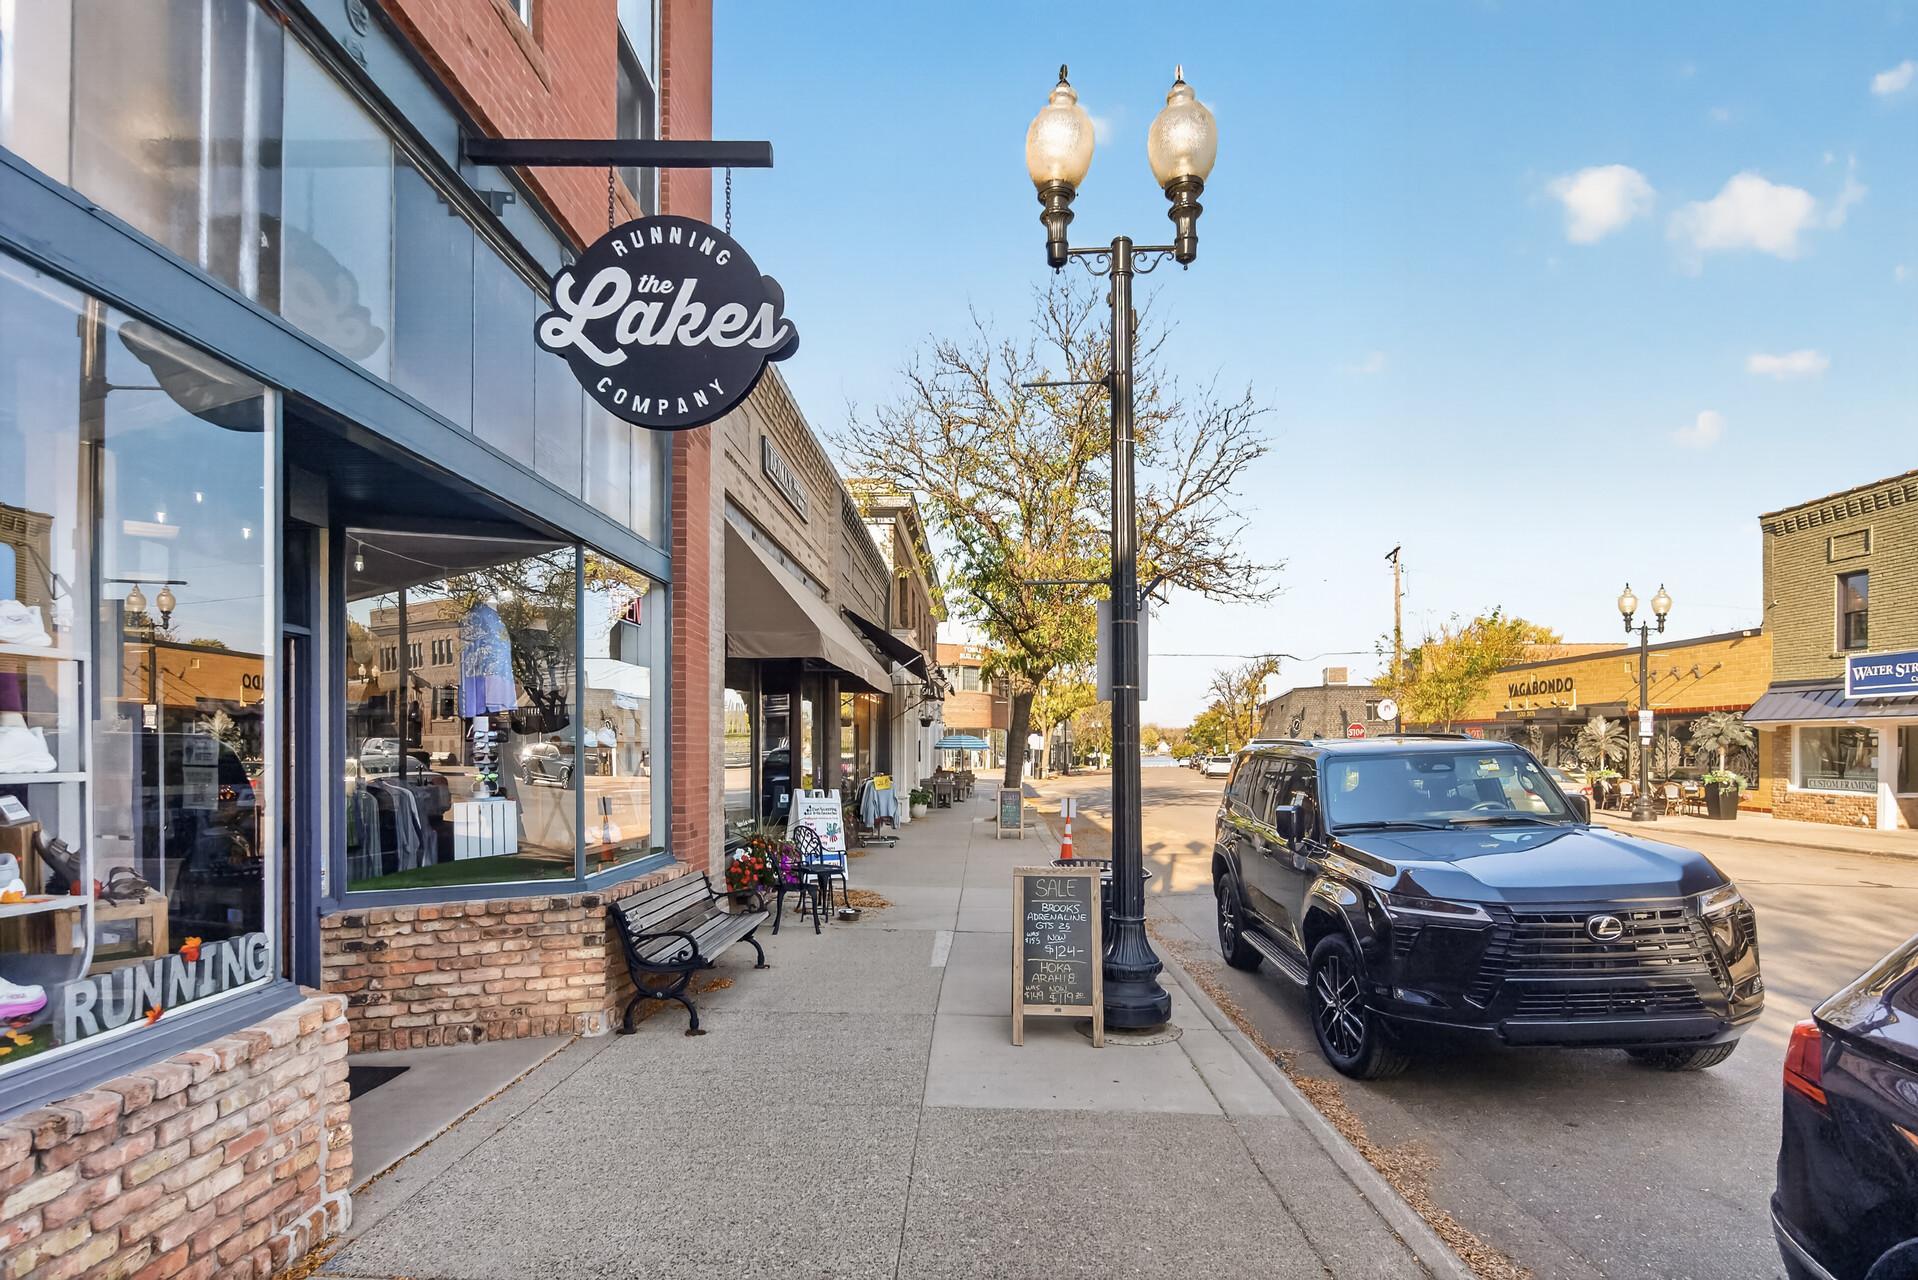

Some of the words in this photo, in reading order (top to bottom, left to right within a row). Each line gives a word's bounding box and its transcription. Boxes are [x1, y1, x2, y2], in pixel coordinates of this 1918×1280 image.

[611, 226, 731, 266] RUNNING
[637, 274, 675, 294] the
[540, 266, 788, 367] Lakes
[596, 376, 724, 416] COMPANY
[1508, 676, 1574, 699] VAGABONDO
[1348, 728, 1364, 737] STOP
[1808, 779, 1839, 789] CUSTOM
[1840, 780, 1876, 790] FRAMING
[1035, 878, 1078, 898] SALE
[1041, 902, 1081, 914] BROOKS
[1026, 911, 1088, 922] ADRENALINE
[1035, 921, 1055, 930] GTS
[1058, 922, 1071, 931] 25
[1040, 961, 1072, 973] HOKA
[1031, 972, 1066, 983] ARAHI
[64, 932, 272, 1043] RUNNING
